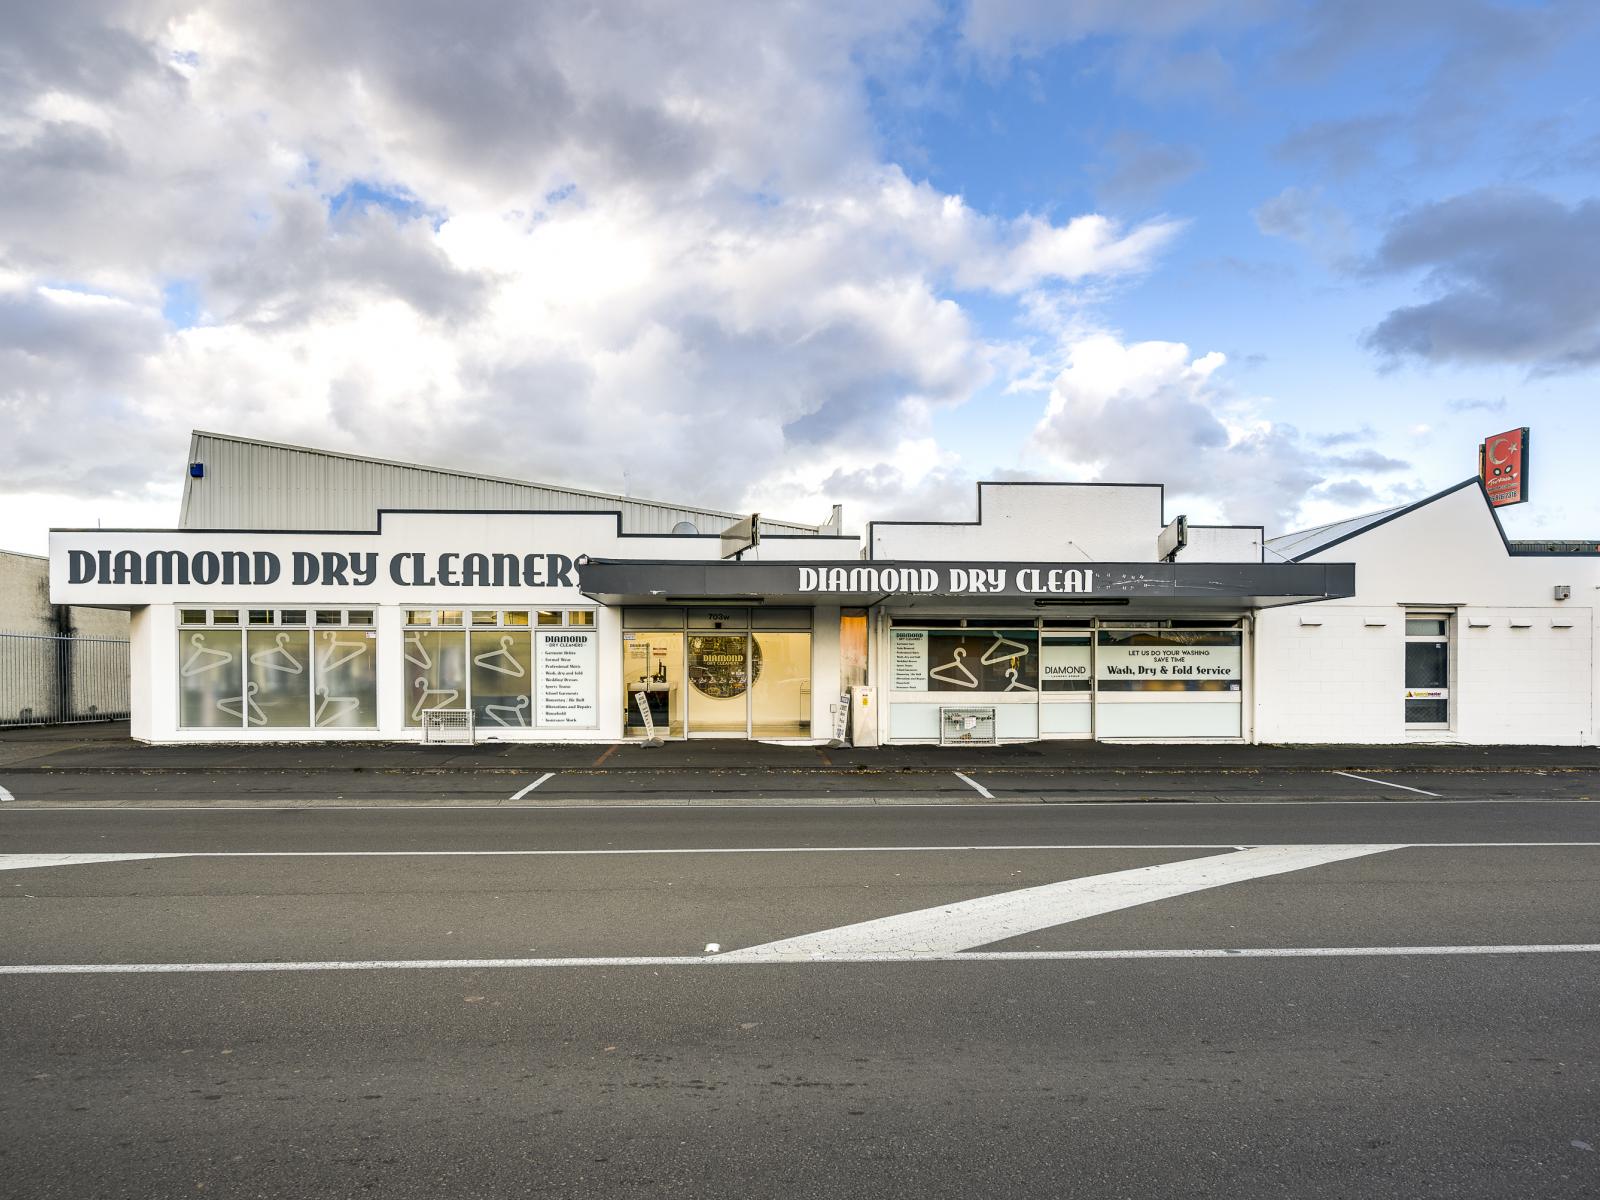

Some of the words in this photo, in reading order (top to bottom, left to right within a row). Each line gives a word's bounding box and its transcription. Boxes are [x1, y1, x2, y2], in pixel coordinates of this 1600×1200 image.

[68, 550, 280, 585] DIAMOND
[291, 552, 378, 586] DRY
[798, 567, 939, 593] DIAMOND
[949, 568, 1007, 593] DRY
[545, 635, 588, 643] DIAMOND
[703, 654, 743, 662] DIAMOND
[1044, 666, 1086, 674] DIAMOND
[1107, 665, 1135, 675] Wash,
[1138, 665, 1157, 676] Dry
[1160, 666, 1168, 675] &
[1172, 665, 1193, 675] Fold
[1196, 665, 1231, 675] Service
